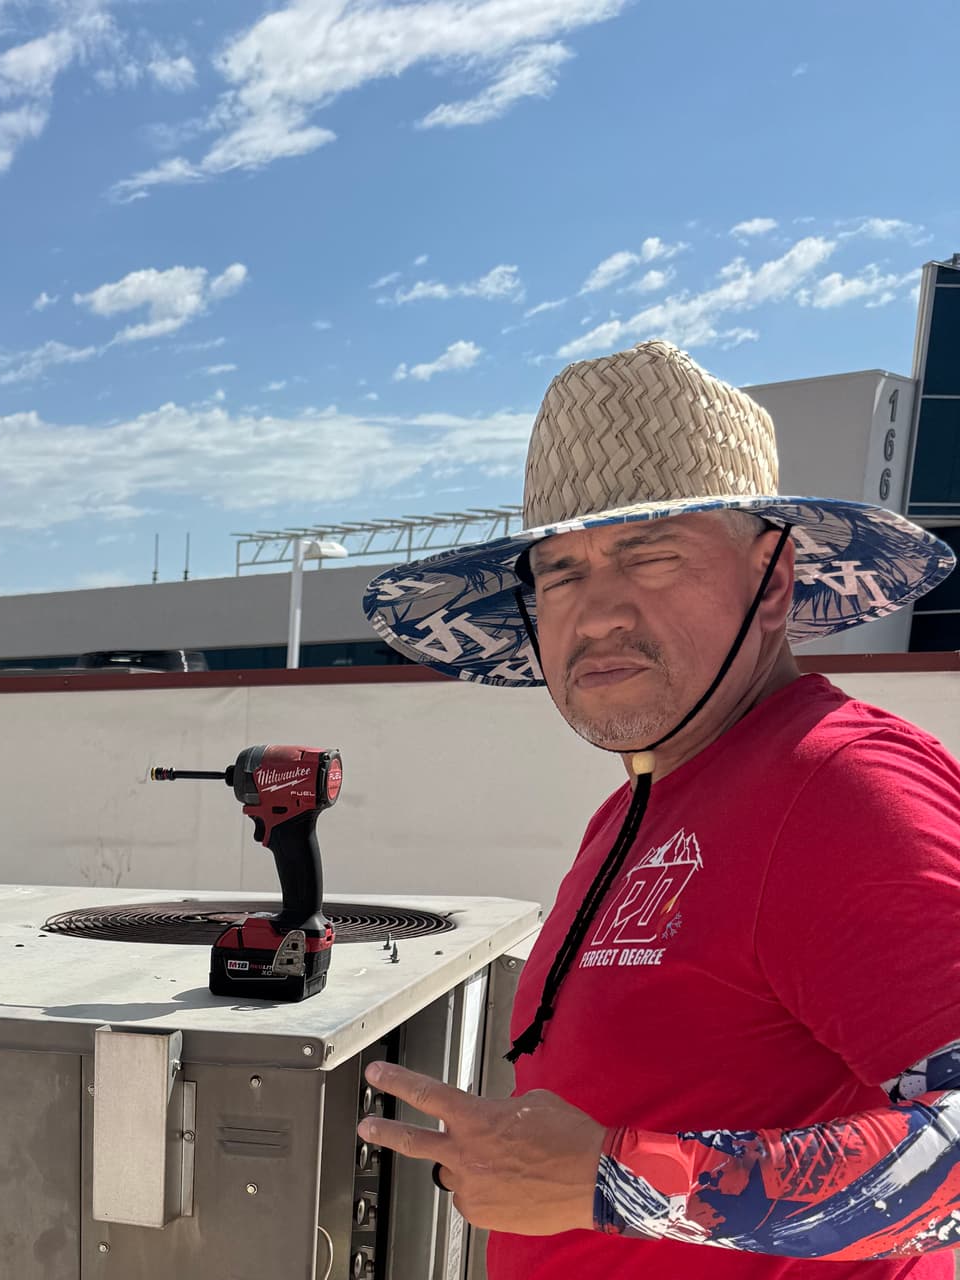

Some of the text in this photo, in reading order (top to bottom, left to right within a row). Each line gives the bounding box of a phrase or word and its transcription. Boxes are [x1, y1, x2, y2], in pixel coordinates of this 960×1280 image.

[256, 766, 311, 786] Milwaukee
[578, 947, 667, 968] PERFECT DEGREE
